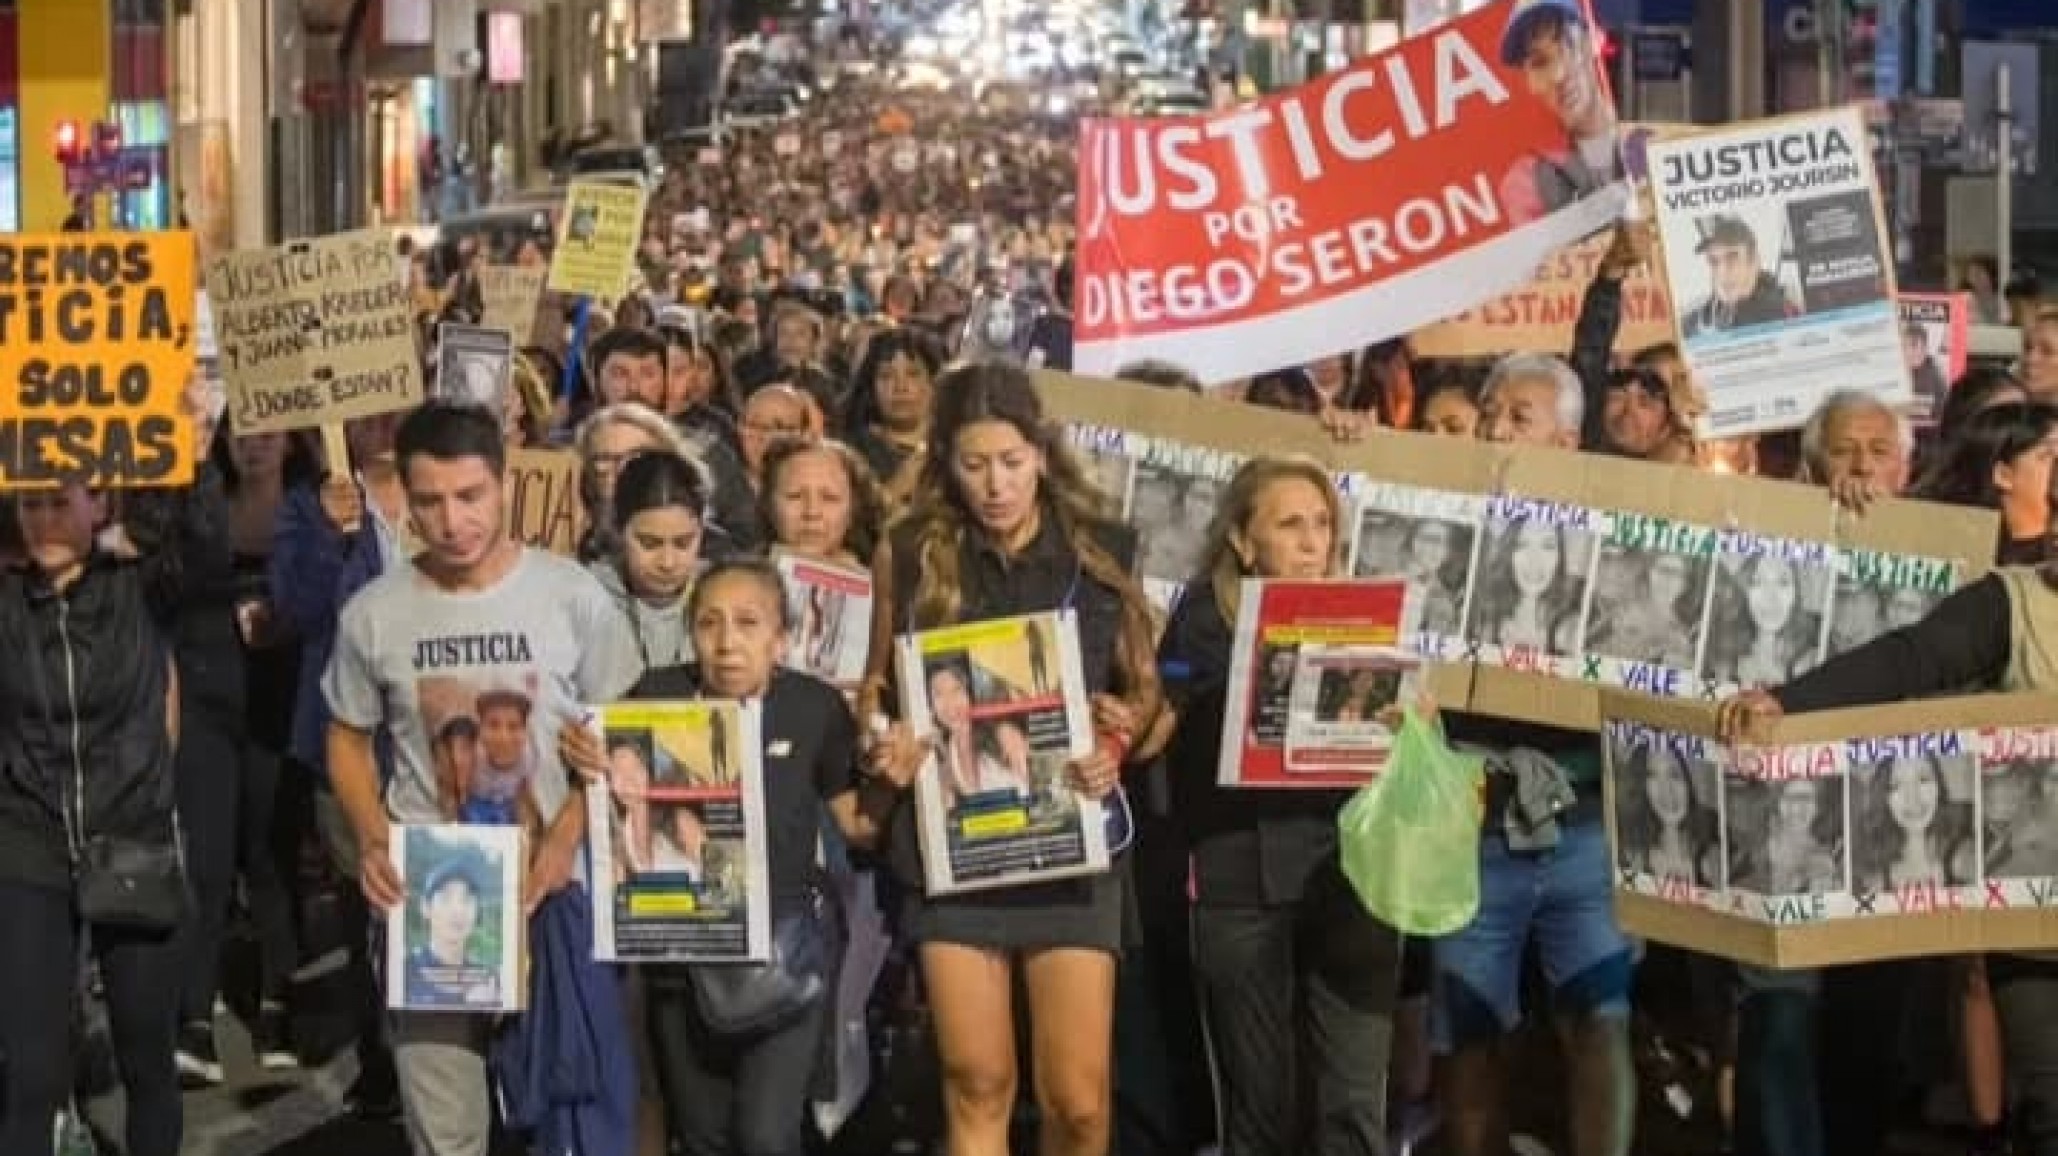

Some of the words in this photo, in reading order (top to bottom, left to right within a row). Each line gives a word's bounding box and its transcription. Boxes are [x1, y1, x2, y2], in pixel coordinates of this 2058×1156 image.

[1086, 29, 1510, 239] JUSTICIA
[1663, 128, 1852, 187] JUSTICIA
[1203, 198, 1304, 247] POR
[1271, 172, 1502, 296] SERON
[211, 248, 341, 302] JUSTICIA
[1082, 260, 1254, 327] DIEGO
[19, 359, 151, 407] SOLO
[508, 467, 573, 552] ICIA
[1486, 494, 1590, 532] JUSTICIA
[1602, 508, 1718, 556] JUSTICIA
[1842, 550, 1955, 598] JUSTICIA
[413, 632, 532, 669] JUSTICIA
[1623, 659, 1680, 696] VALE
[1848, 729, 1960, 766] JUSTICIA
[1762, 893, 1825, 922] VALE
